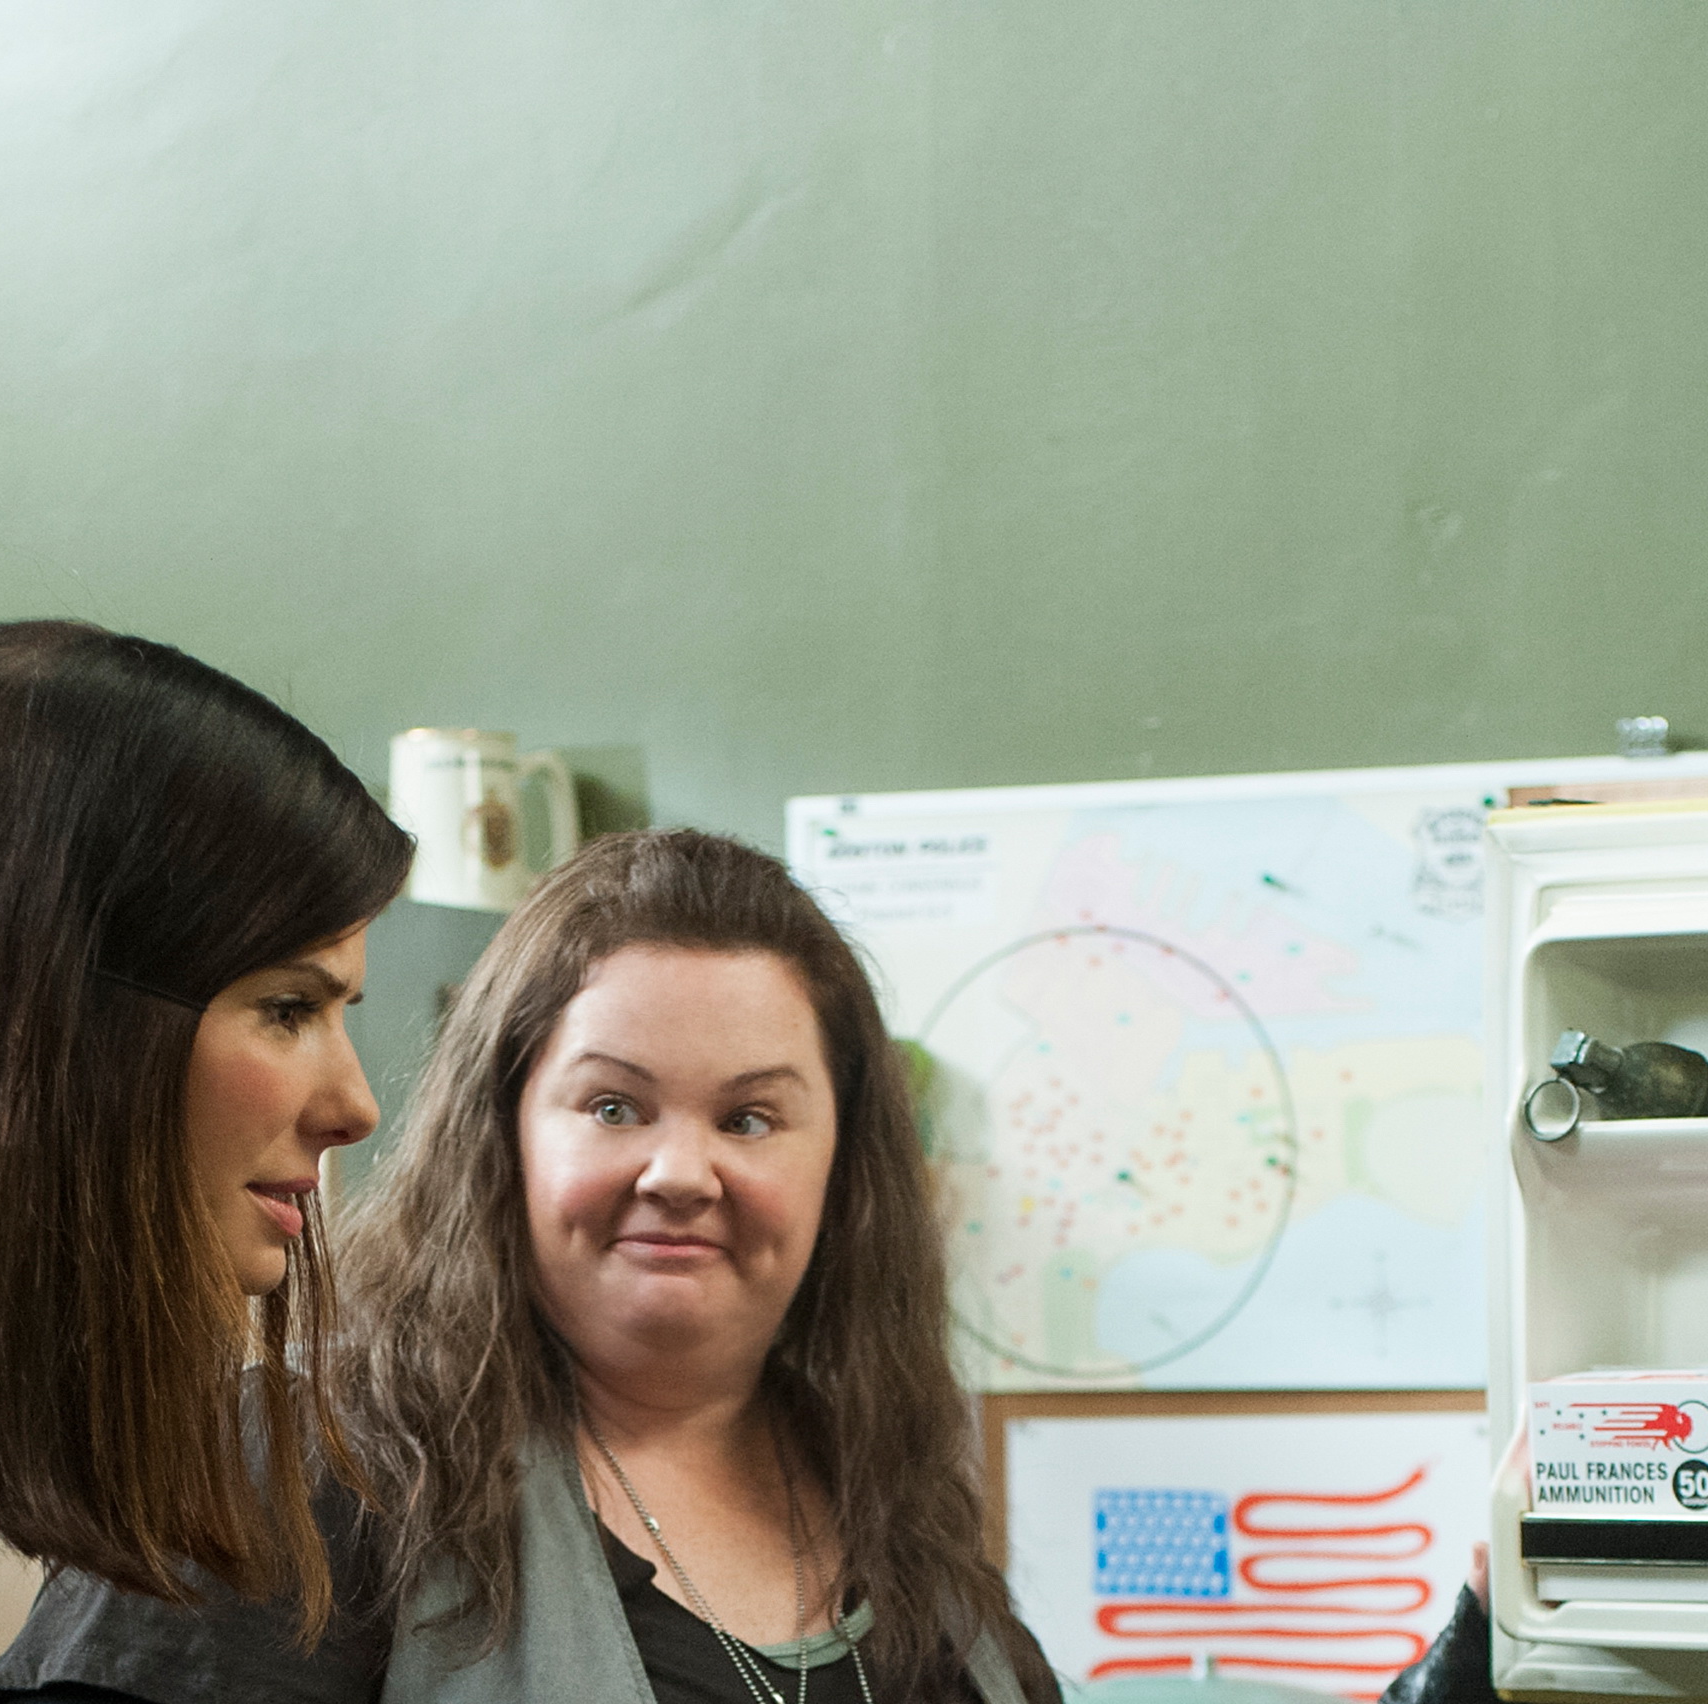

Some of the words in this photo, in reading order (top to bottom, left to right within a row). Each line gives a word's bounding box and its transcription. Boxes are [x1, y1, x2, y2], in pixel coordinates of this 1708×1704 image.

[1536, 1462, 1579, 1480] PAUL
[1587, 1462, 1668, 1481] FRANCES
[1538, 1485, 1655, 1504] AMMUNITION
